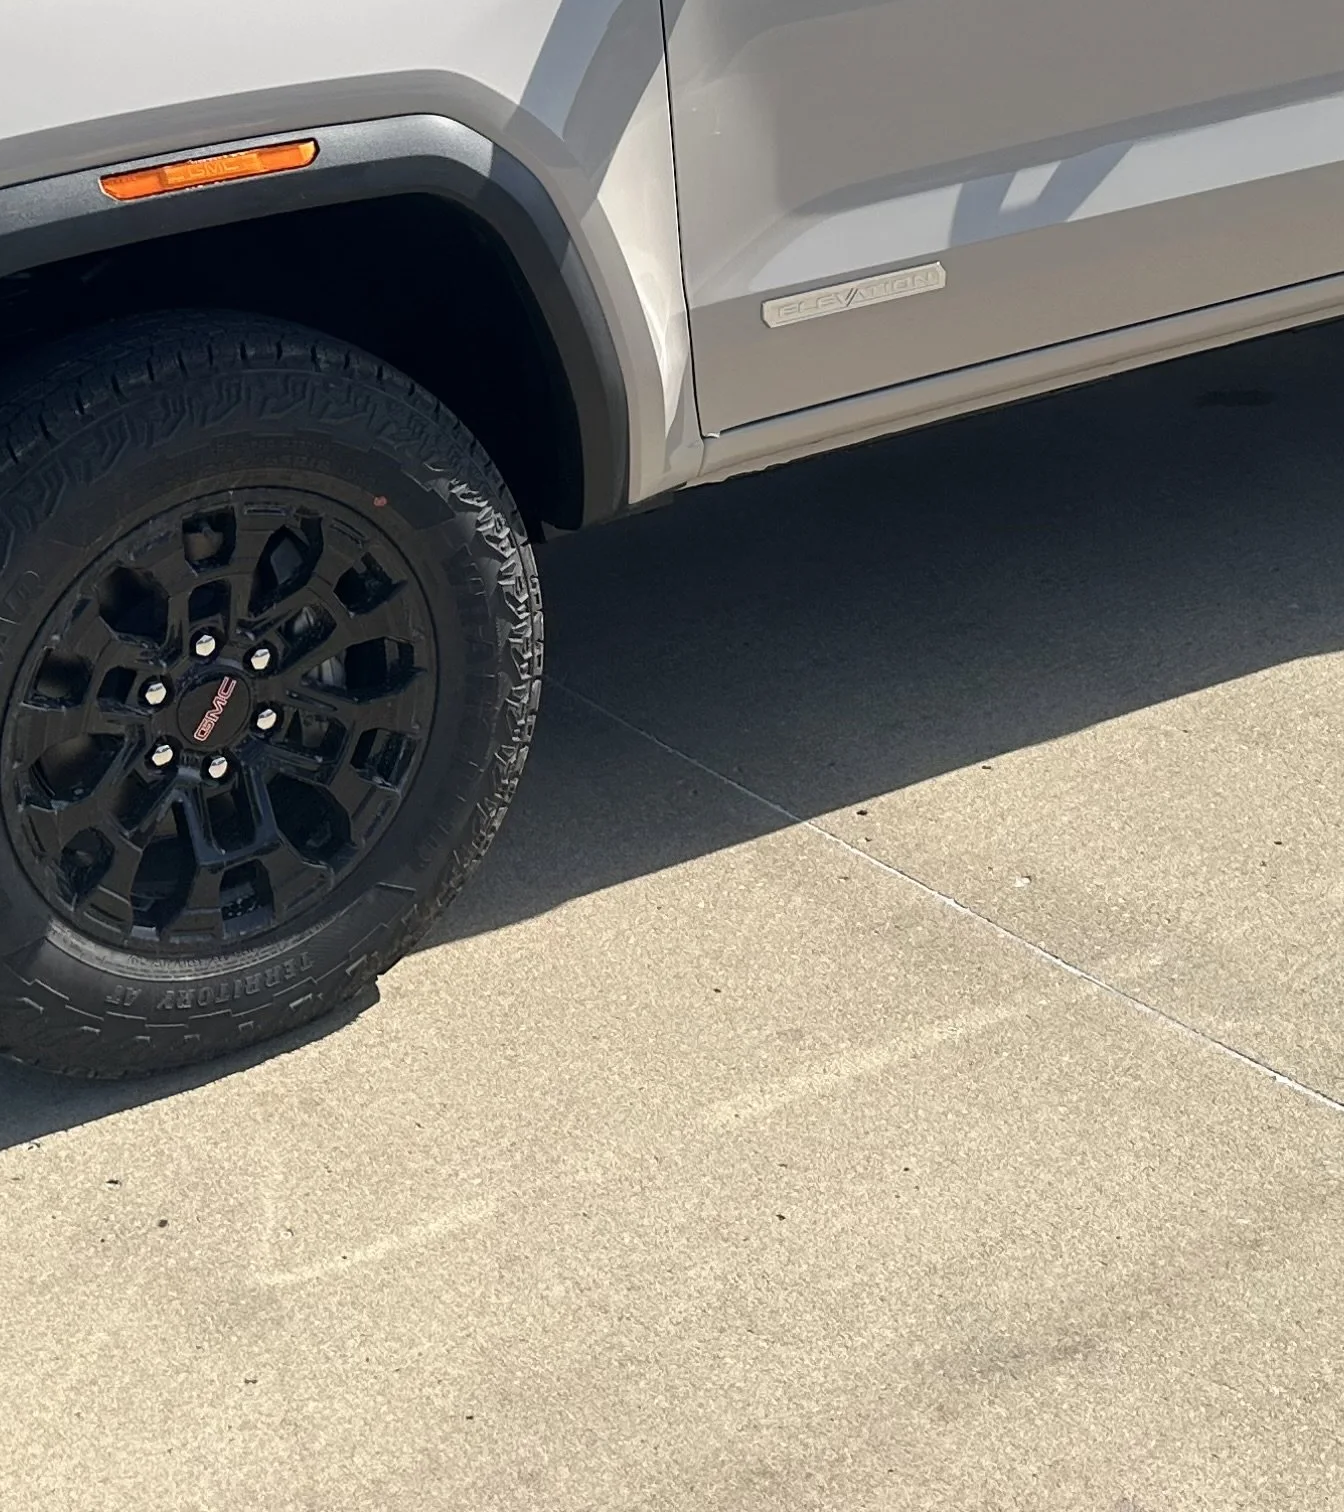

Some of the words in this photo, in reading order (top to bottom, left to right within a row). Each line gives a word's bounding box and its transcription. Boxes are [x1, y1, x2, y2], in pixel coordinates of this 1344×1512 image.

[776, 270, 936, 319] ELEVATION
[193, 675, 238, 742] GMC
[156, 951, 315, 1010] TERRITORY
